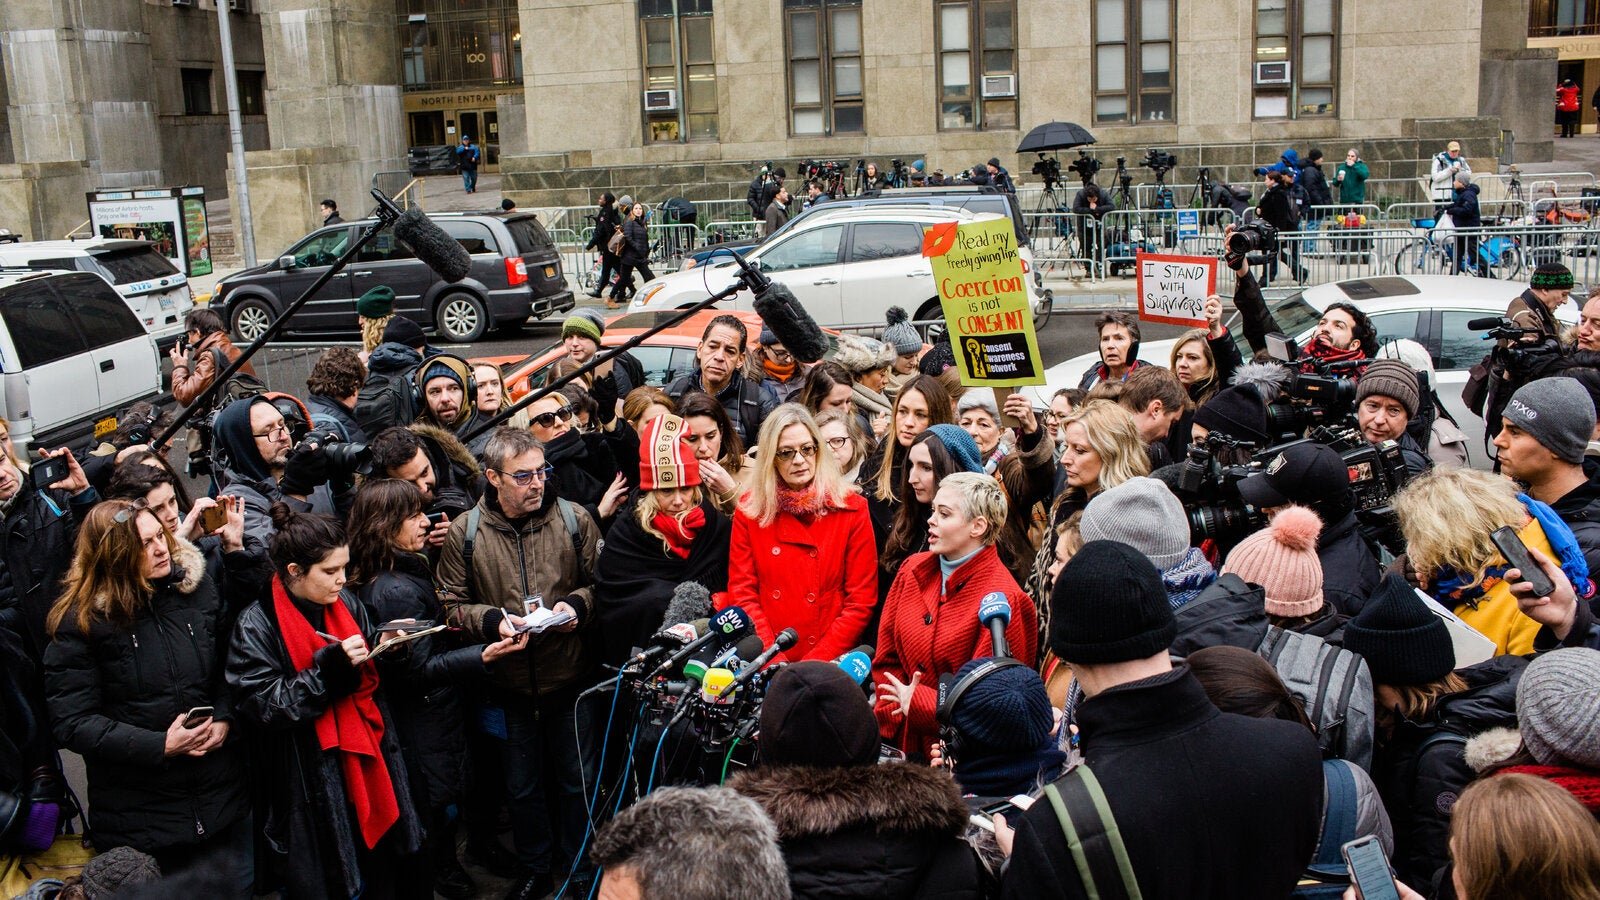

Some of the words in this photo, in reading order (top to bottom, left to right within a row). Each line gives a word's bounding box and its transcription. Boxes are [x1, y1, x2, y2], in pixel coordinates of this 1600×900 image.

[466, 53, 486, 63] 100
[421, 96, 454, 105] NORTH
[956, 229, 989, 250] Read
[992, 231, 1009, 250] my
[1144, 263, 1155, 277] I
[1164, 264, 1204, 280] STAND
[130, 282, 152, 292] NYPD
[942, 274, 1022, 300] Coercion
[1160, 282, 1185, 294] WITH
[967, 300, 978, 313] is
[980, 296, 1001, 311] not
[957, 308, 1026, 335] CONSENT
[981, 342, 1013, 353] Consent
[984, 352, 1026, 363] Awareness
[986, 362, 1018, 373] Network
